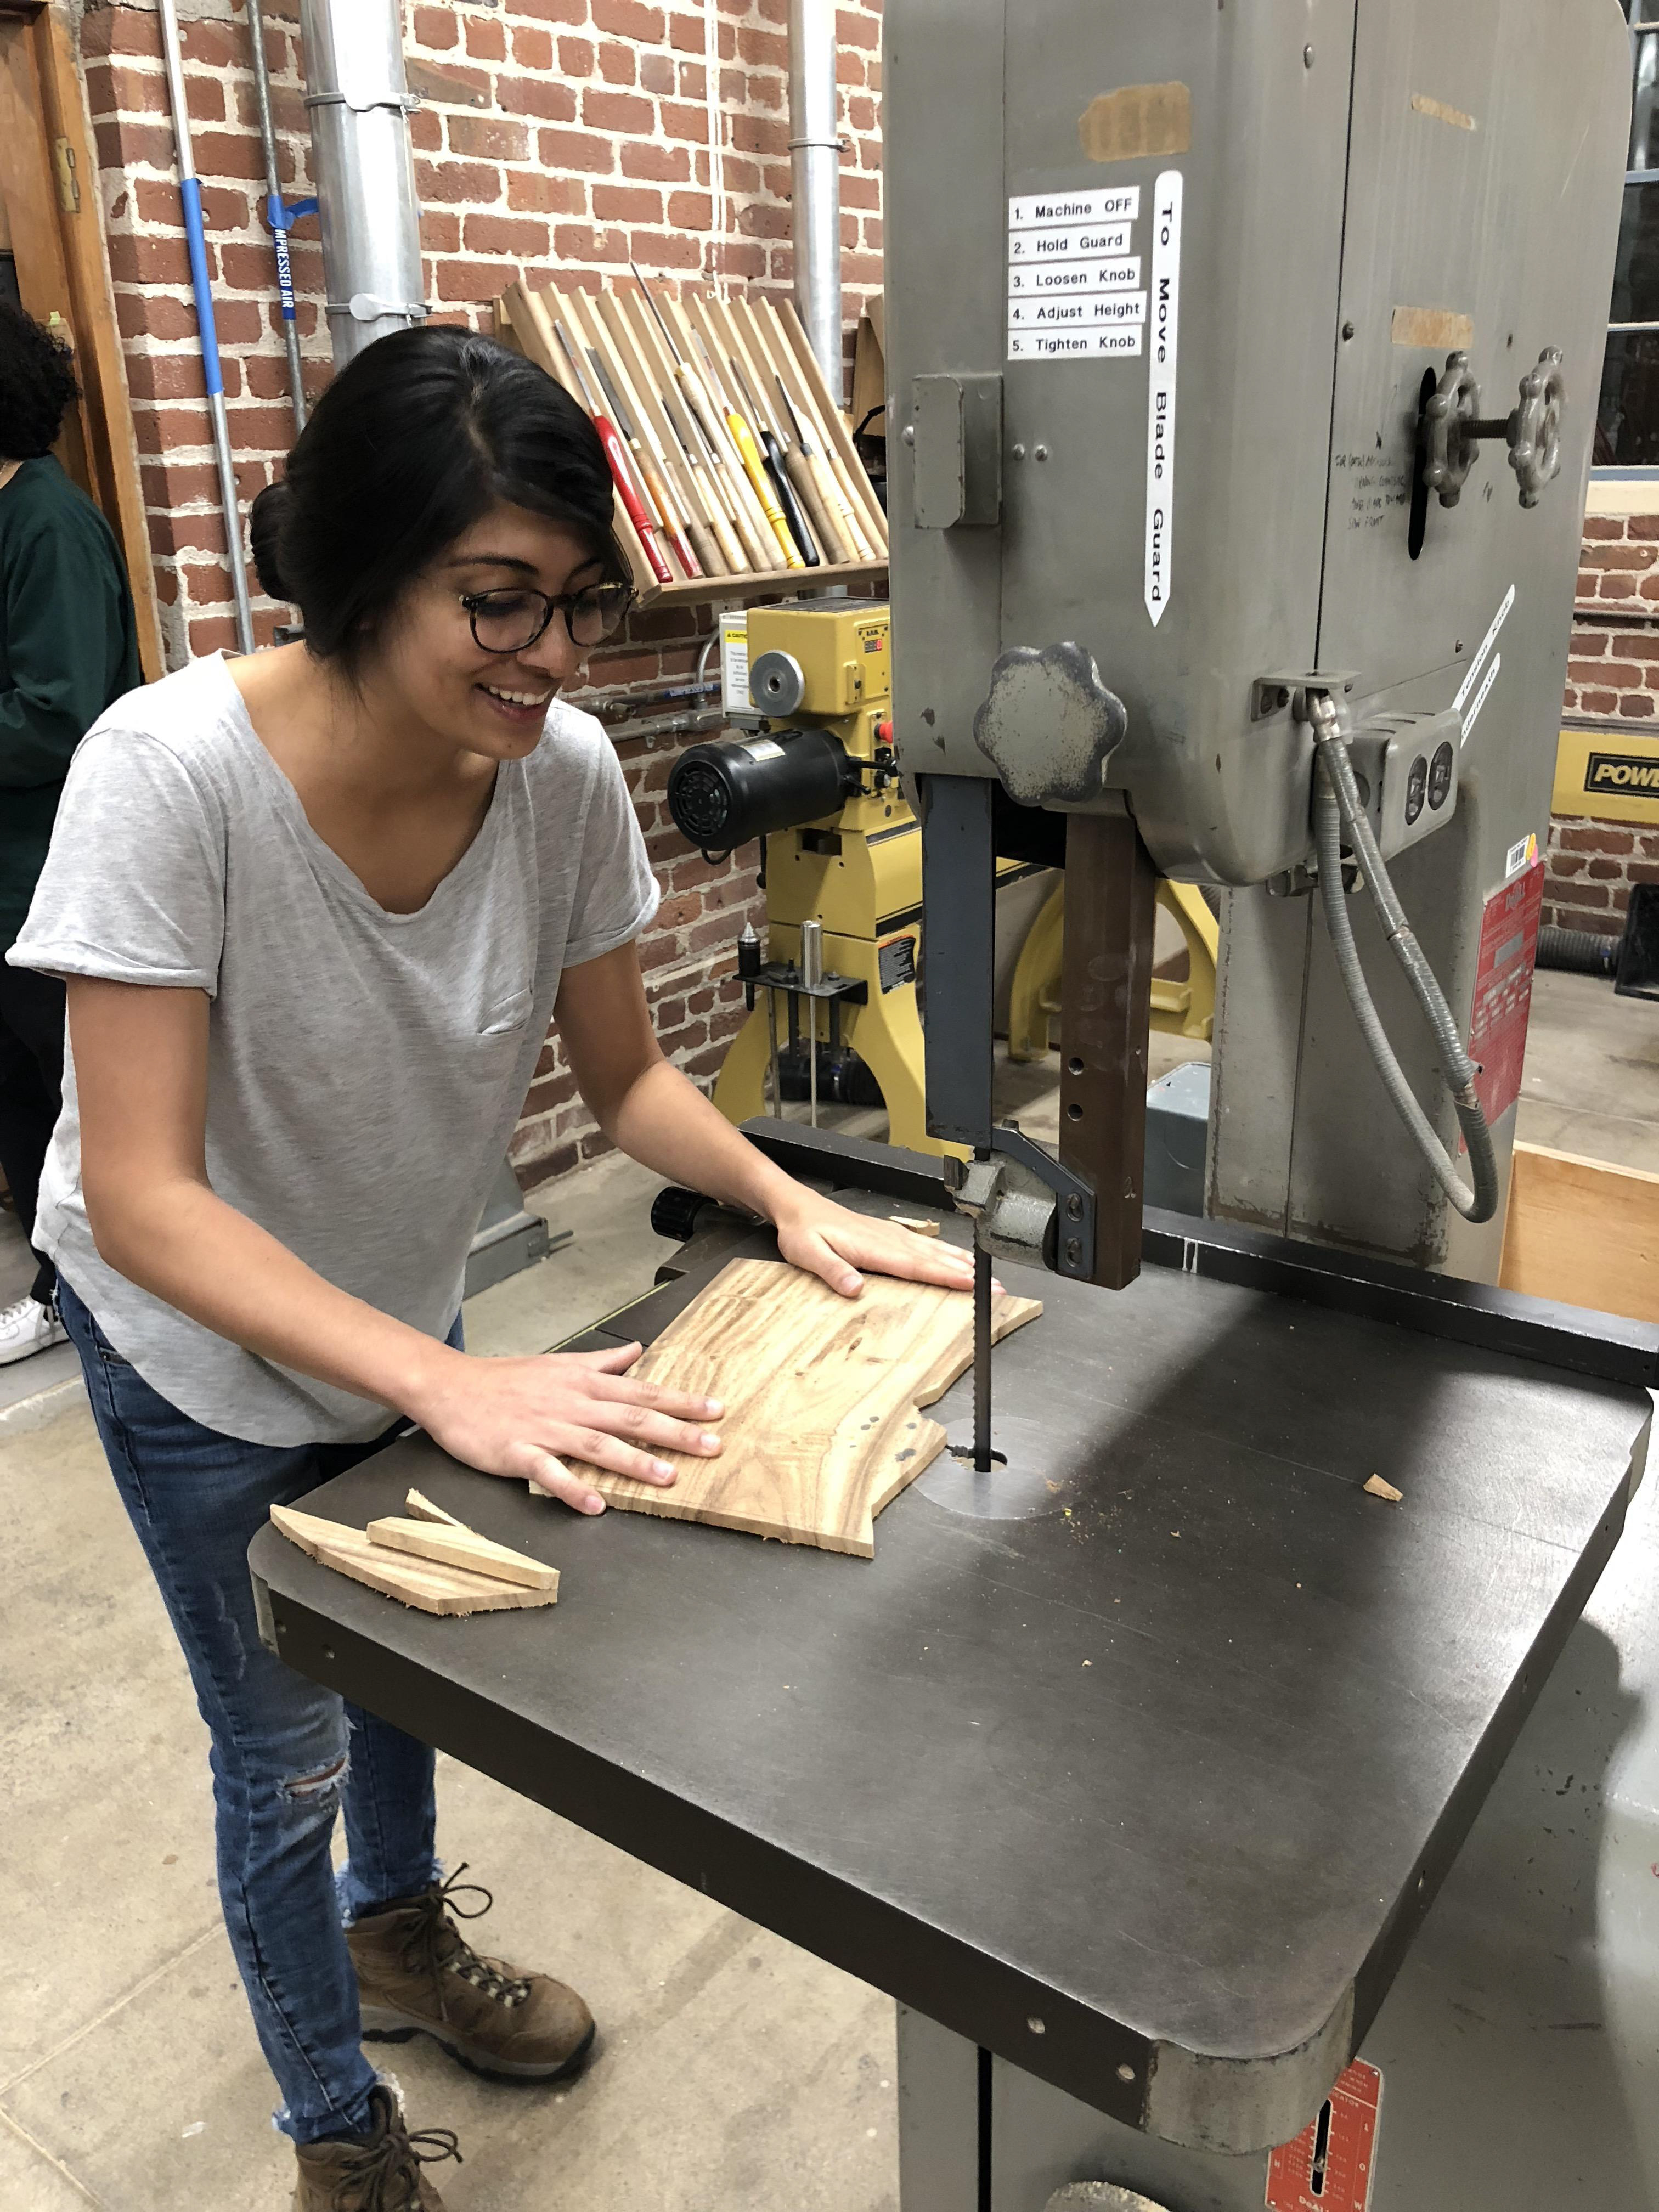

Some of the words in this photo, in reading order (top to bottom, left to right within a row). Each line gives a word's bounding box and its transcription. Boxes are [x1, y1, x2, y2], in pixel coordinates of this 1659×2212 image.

[1015, 208, 1023, 220] 1.
[1035, 203, 1092, 218] Machine
[1105, 198, 1131, 212] OFF
[1161, 201, 1172, 246] To
[1014, 242, 1025, 255] 2.
[1037, 238, 1068, 252] Hold
[1080, 234, 1123, 249] Guard
[1013, 275, 1024, 287] 3.
[1036, 274, 1087, 286] Loosen
[1099, 268, 1135, 282] Knob
[281, 290, 294, 308] AIR
[1013, 308, 1024, 320] 4.
[1037, 306, 1082, 320] Adjust
[1094, 303, 1141, 319] Height
[1158, 278, 1170, 363] Move
[1013, 340, 1023, 352] 5.
[1035, 338, 1087, 353] Tighten
[1099, 335, 1136, 348] Knob
[1154, 392, 1167, 479] Blade
[1152, 509, 1164, 601] Guard
[1462, 645, 1487, 696] Tension
[1492, 601, 1509, 635] Knob
